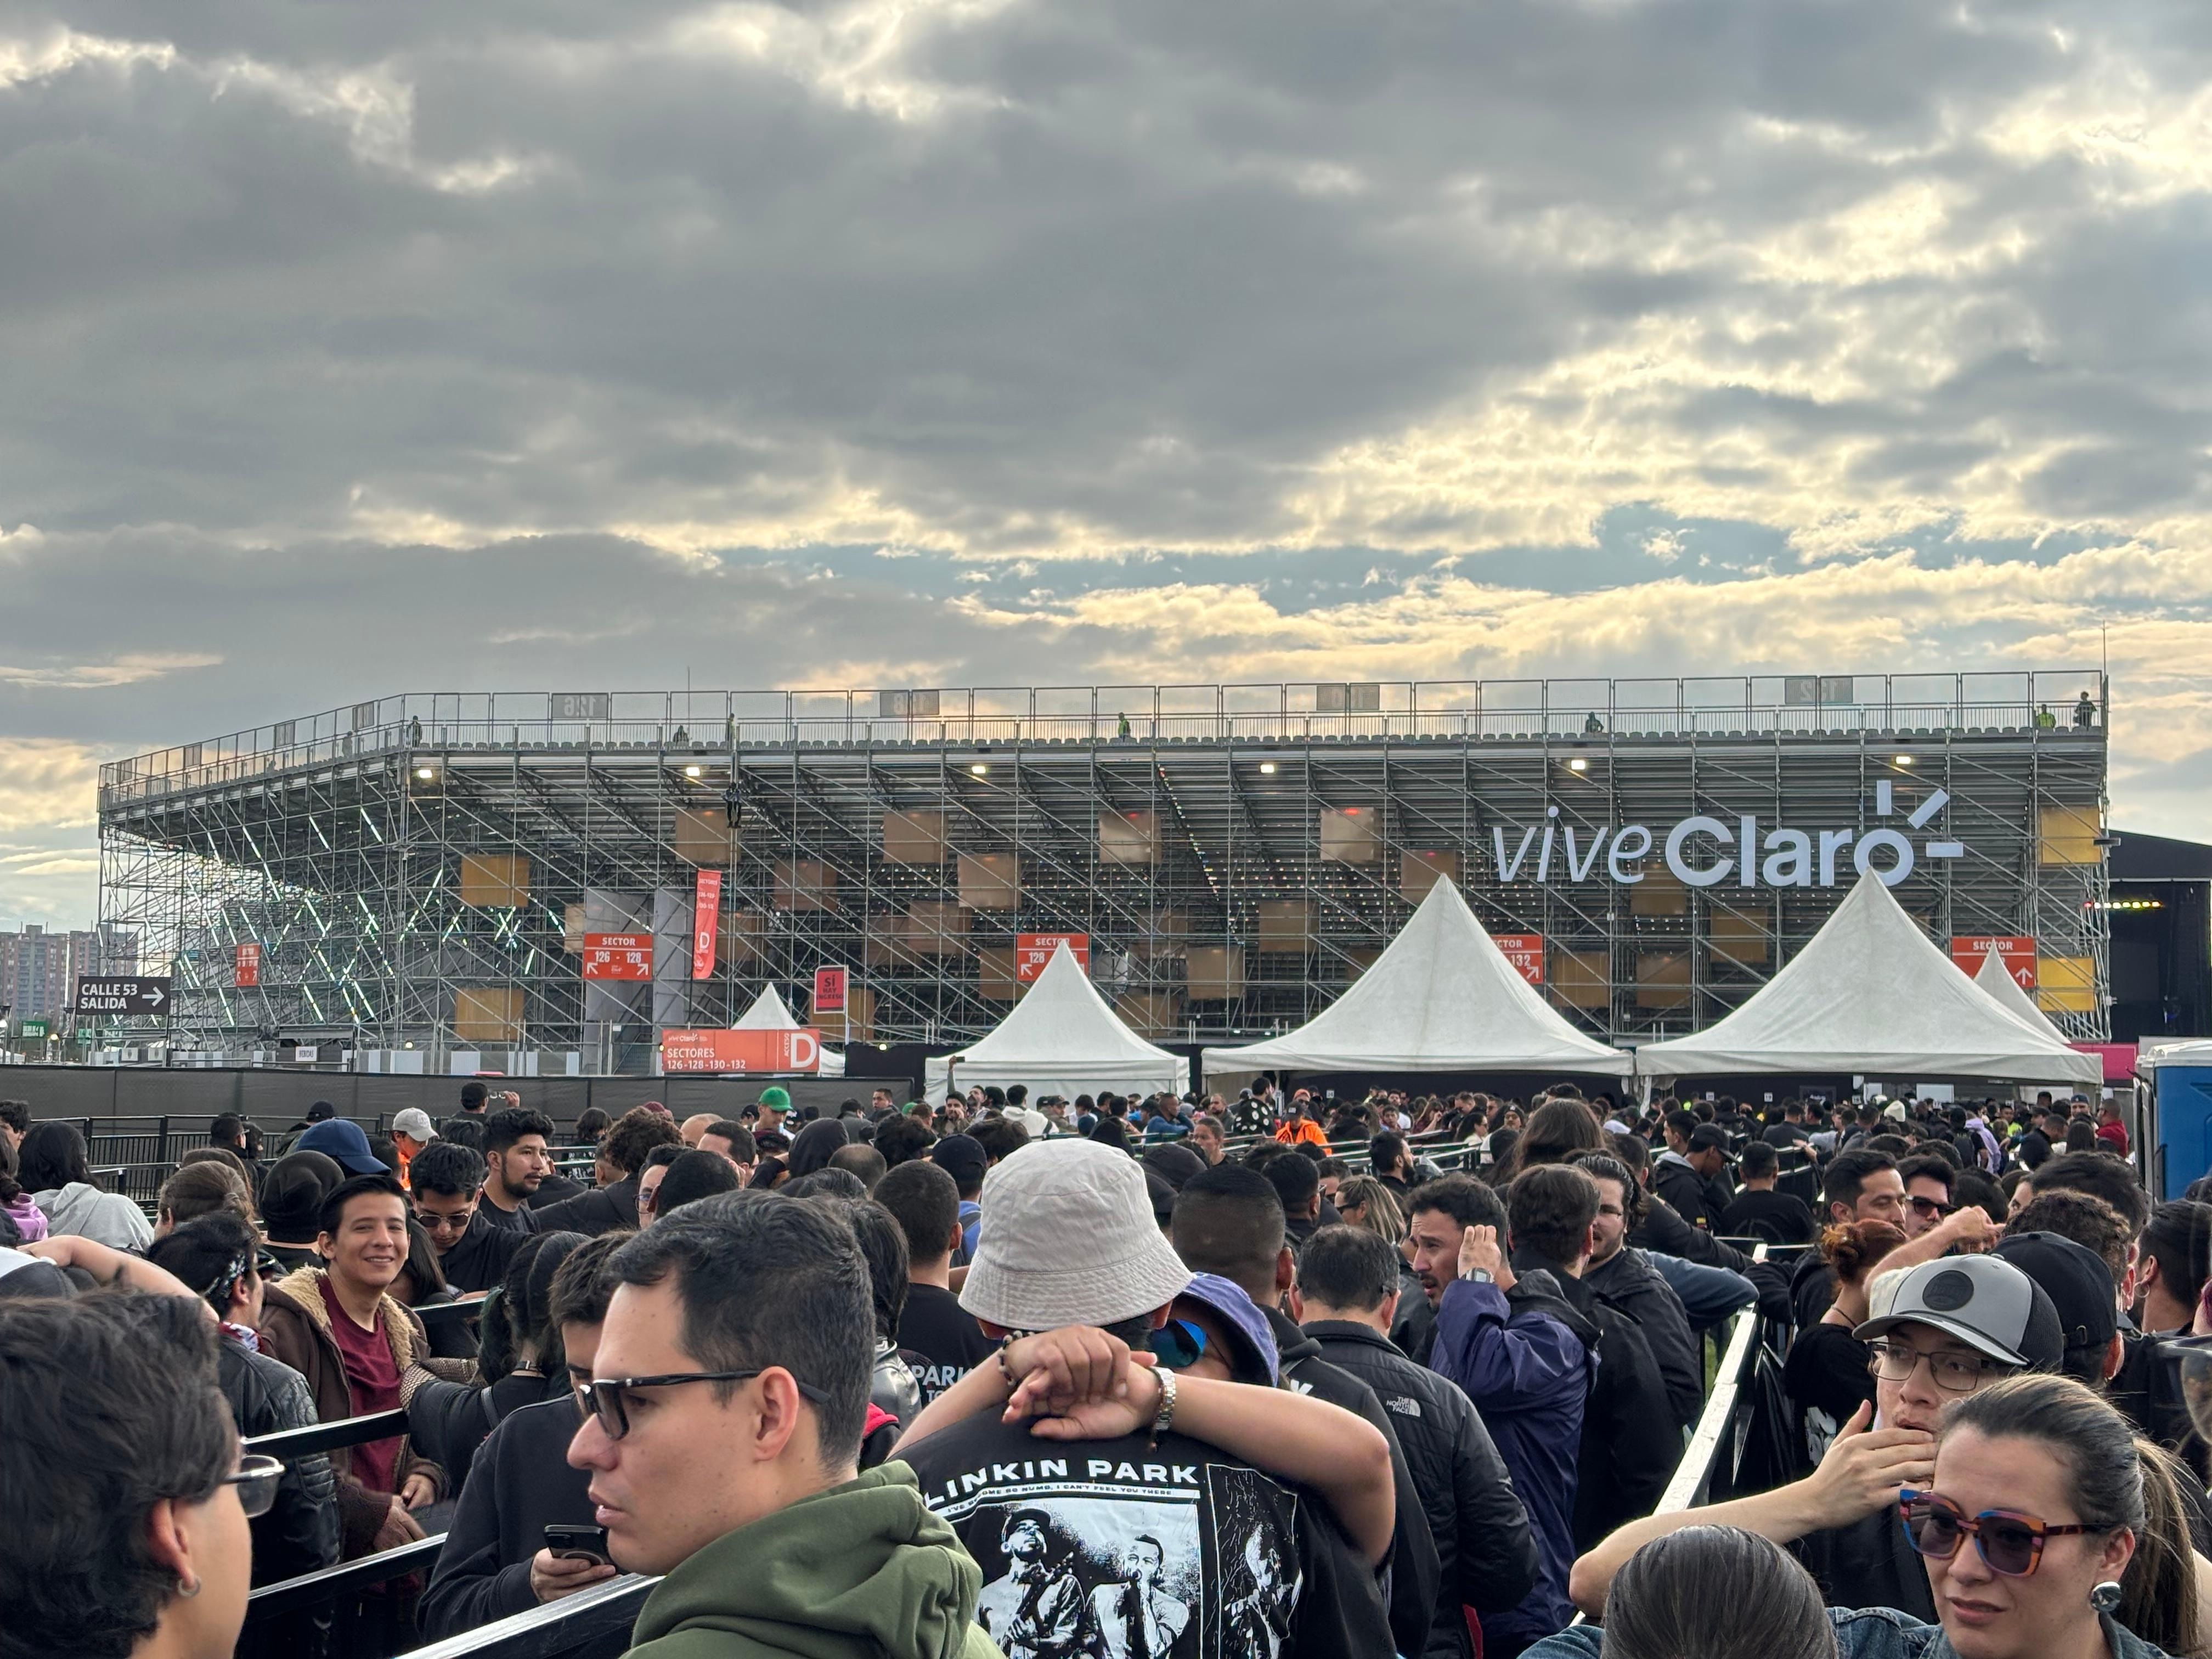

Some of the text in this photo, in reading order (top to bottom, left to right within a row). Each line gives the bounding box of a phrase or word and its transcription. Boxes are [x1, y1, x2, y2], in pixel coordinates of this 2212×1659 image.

[1493, 806, 1915, 887] vive Claro
[602, 937, 636, 946] SECTOR
[699, 932, 710, 949] D
[1973, 941, 2013, 950] SECOR
[595, 951, 610, 963] 126
[627, 952, 641, 964] 128
[1029, 952, 1045, 963] 128
[1511, 955, 1531, 967] 132
[825, 974, 835, 987] SÍ
[82, 984, 138, 996] CALLE 53
[80, 997, 127, 1009] SALIDA
[667, 1048, 715, 1058] SECTORES
[791, 1033, 817, 1068] D
[1386, 1400, 1409, 1409] NORTH
[1392, 1406, 1409, 1414] FACE
[924, 1459, 1199, 1509] LINKIN PARK
